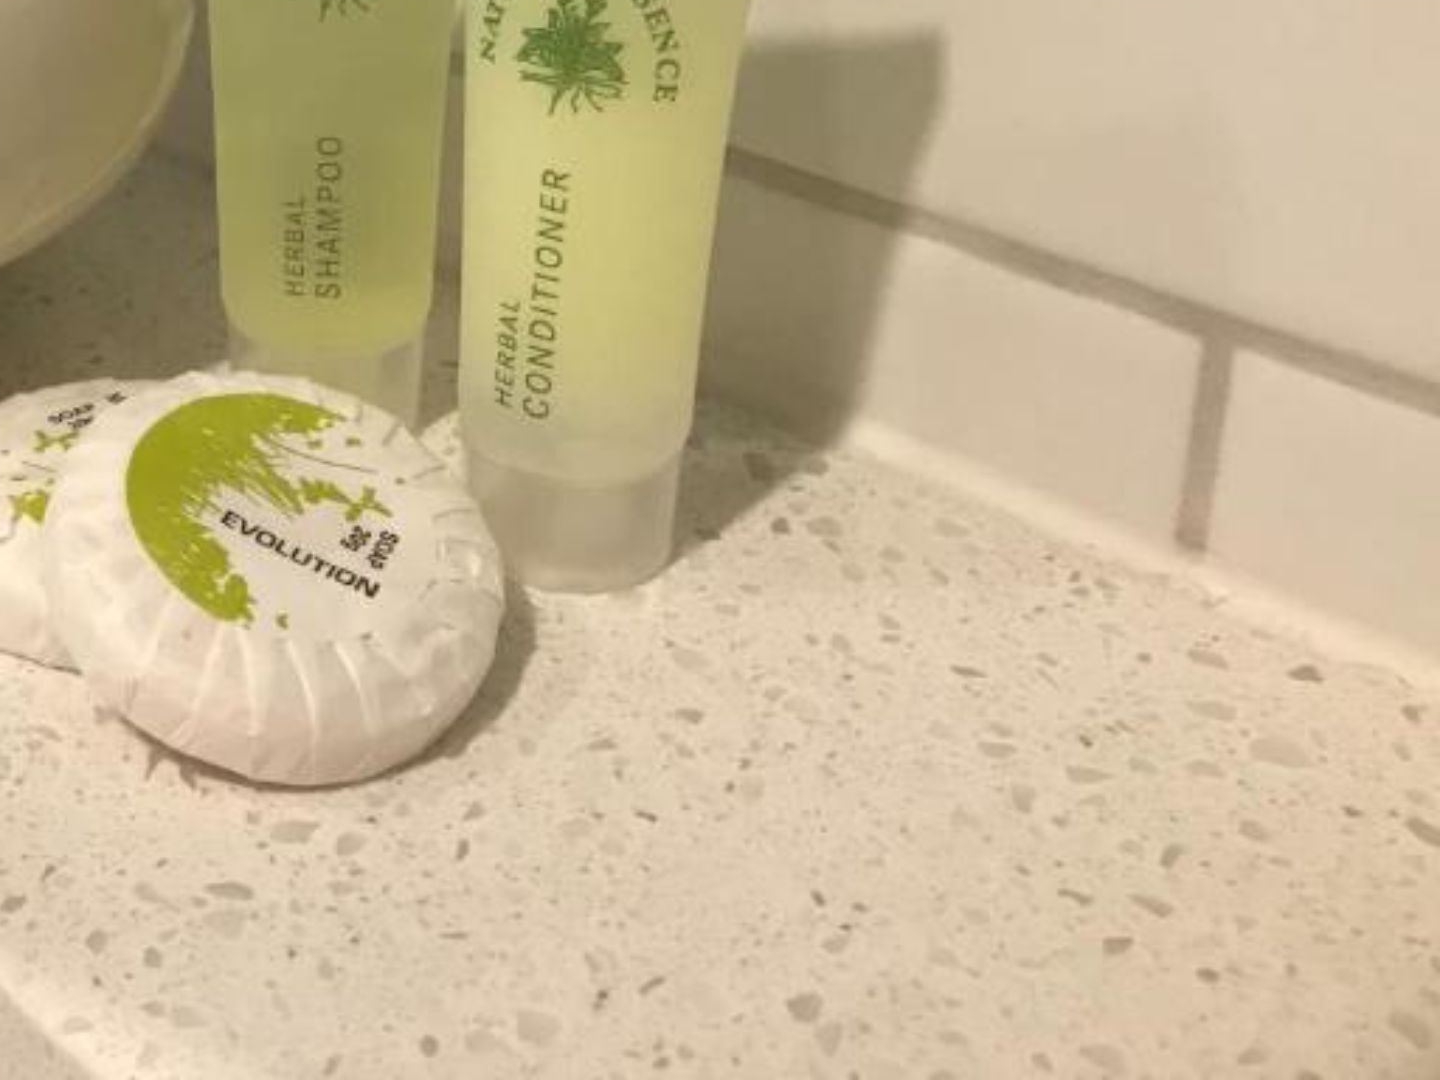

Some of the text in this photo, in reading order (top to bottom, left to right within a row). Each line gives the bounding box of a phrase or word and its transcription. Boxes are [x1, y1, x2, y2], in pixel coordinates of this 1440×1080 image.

[283, 196, 306, 298] HERBAL
[315, 135, 344, 300] SHAMPOO
[522, 167, 572, 421] CONDITIONER
[493, 299, 522, 409] HERBAL
[219, 509, 381, 600] EVOLUTION
[366, 530, 400, 570] SOAP
